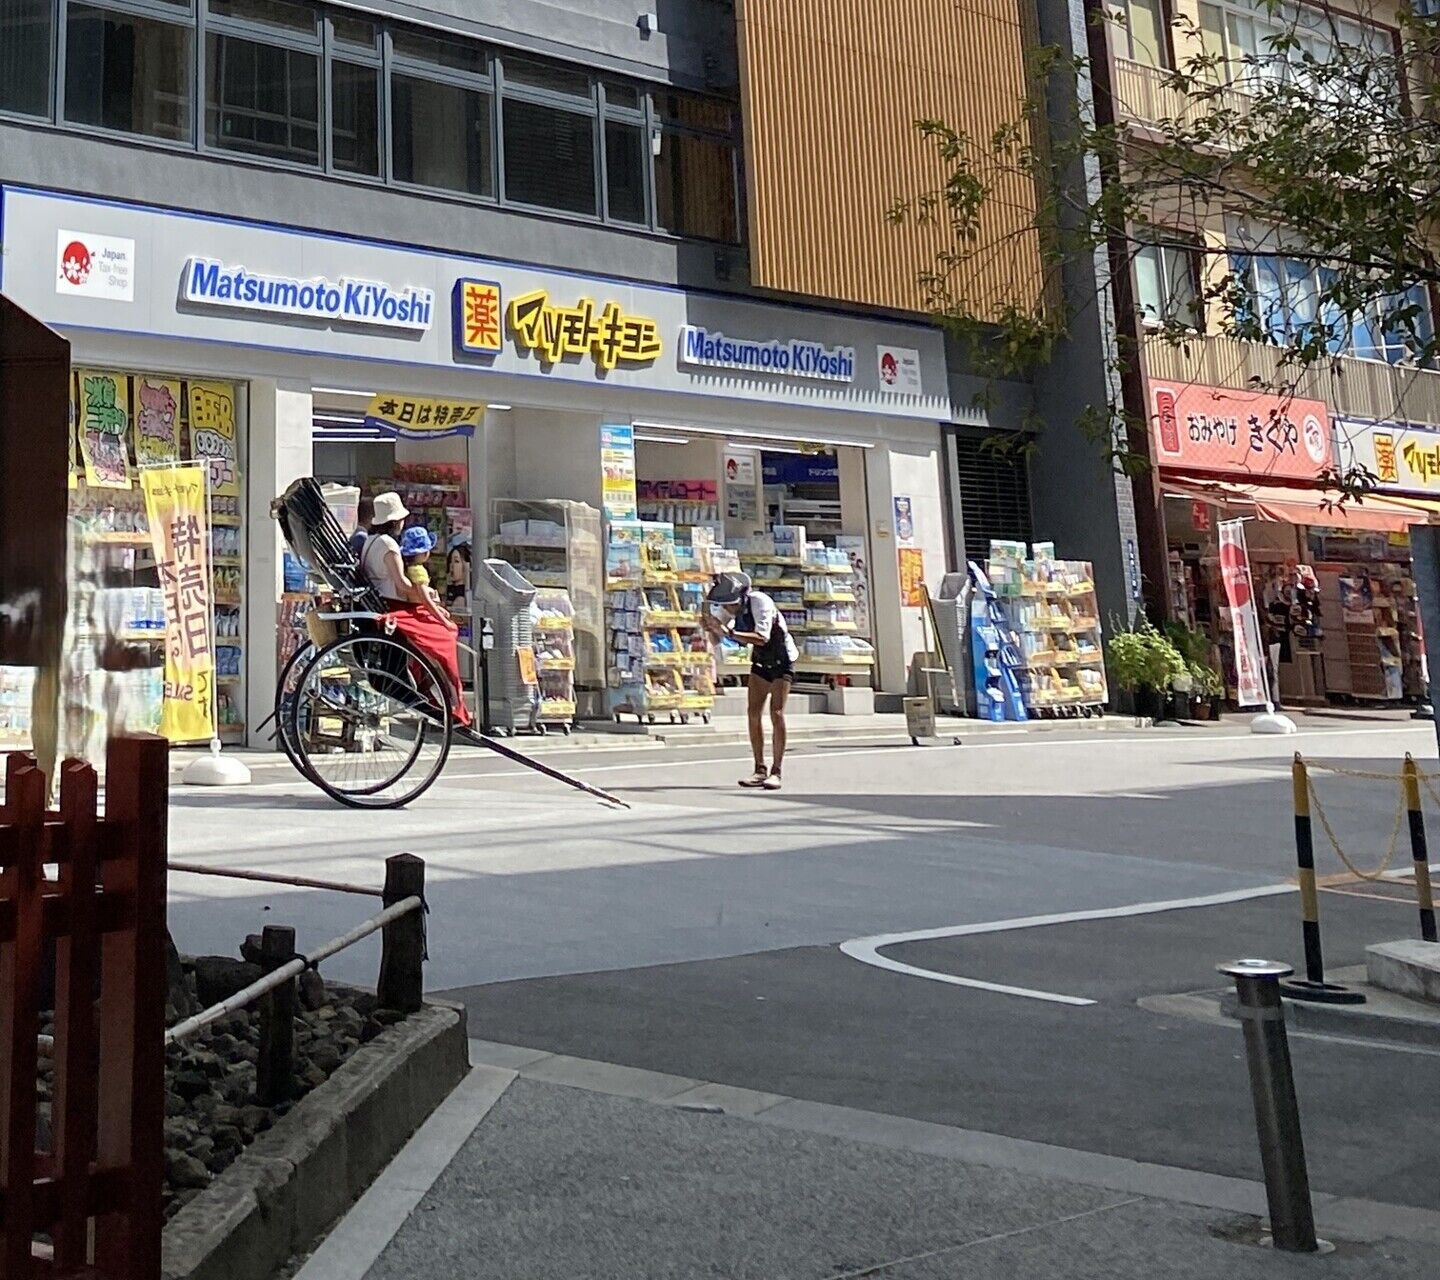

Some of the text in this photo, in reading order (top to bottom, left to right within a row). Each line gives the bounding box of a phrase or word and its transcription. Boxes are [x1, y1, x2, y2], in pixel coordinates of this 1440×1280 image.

[190, 261, 432, 325] Matsumoto KiYoshi
[466, 286, 661, 364] 薬 マツモトキヨシ
[686, 330, 854, 378] Matsumoto KiYoshi
